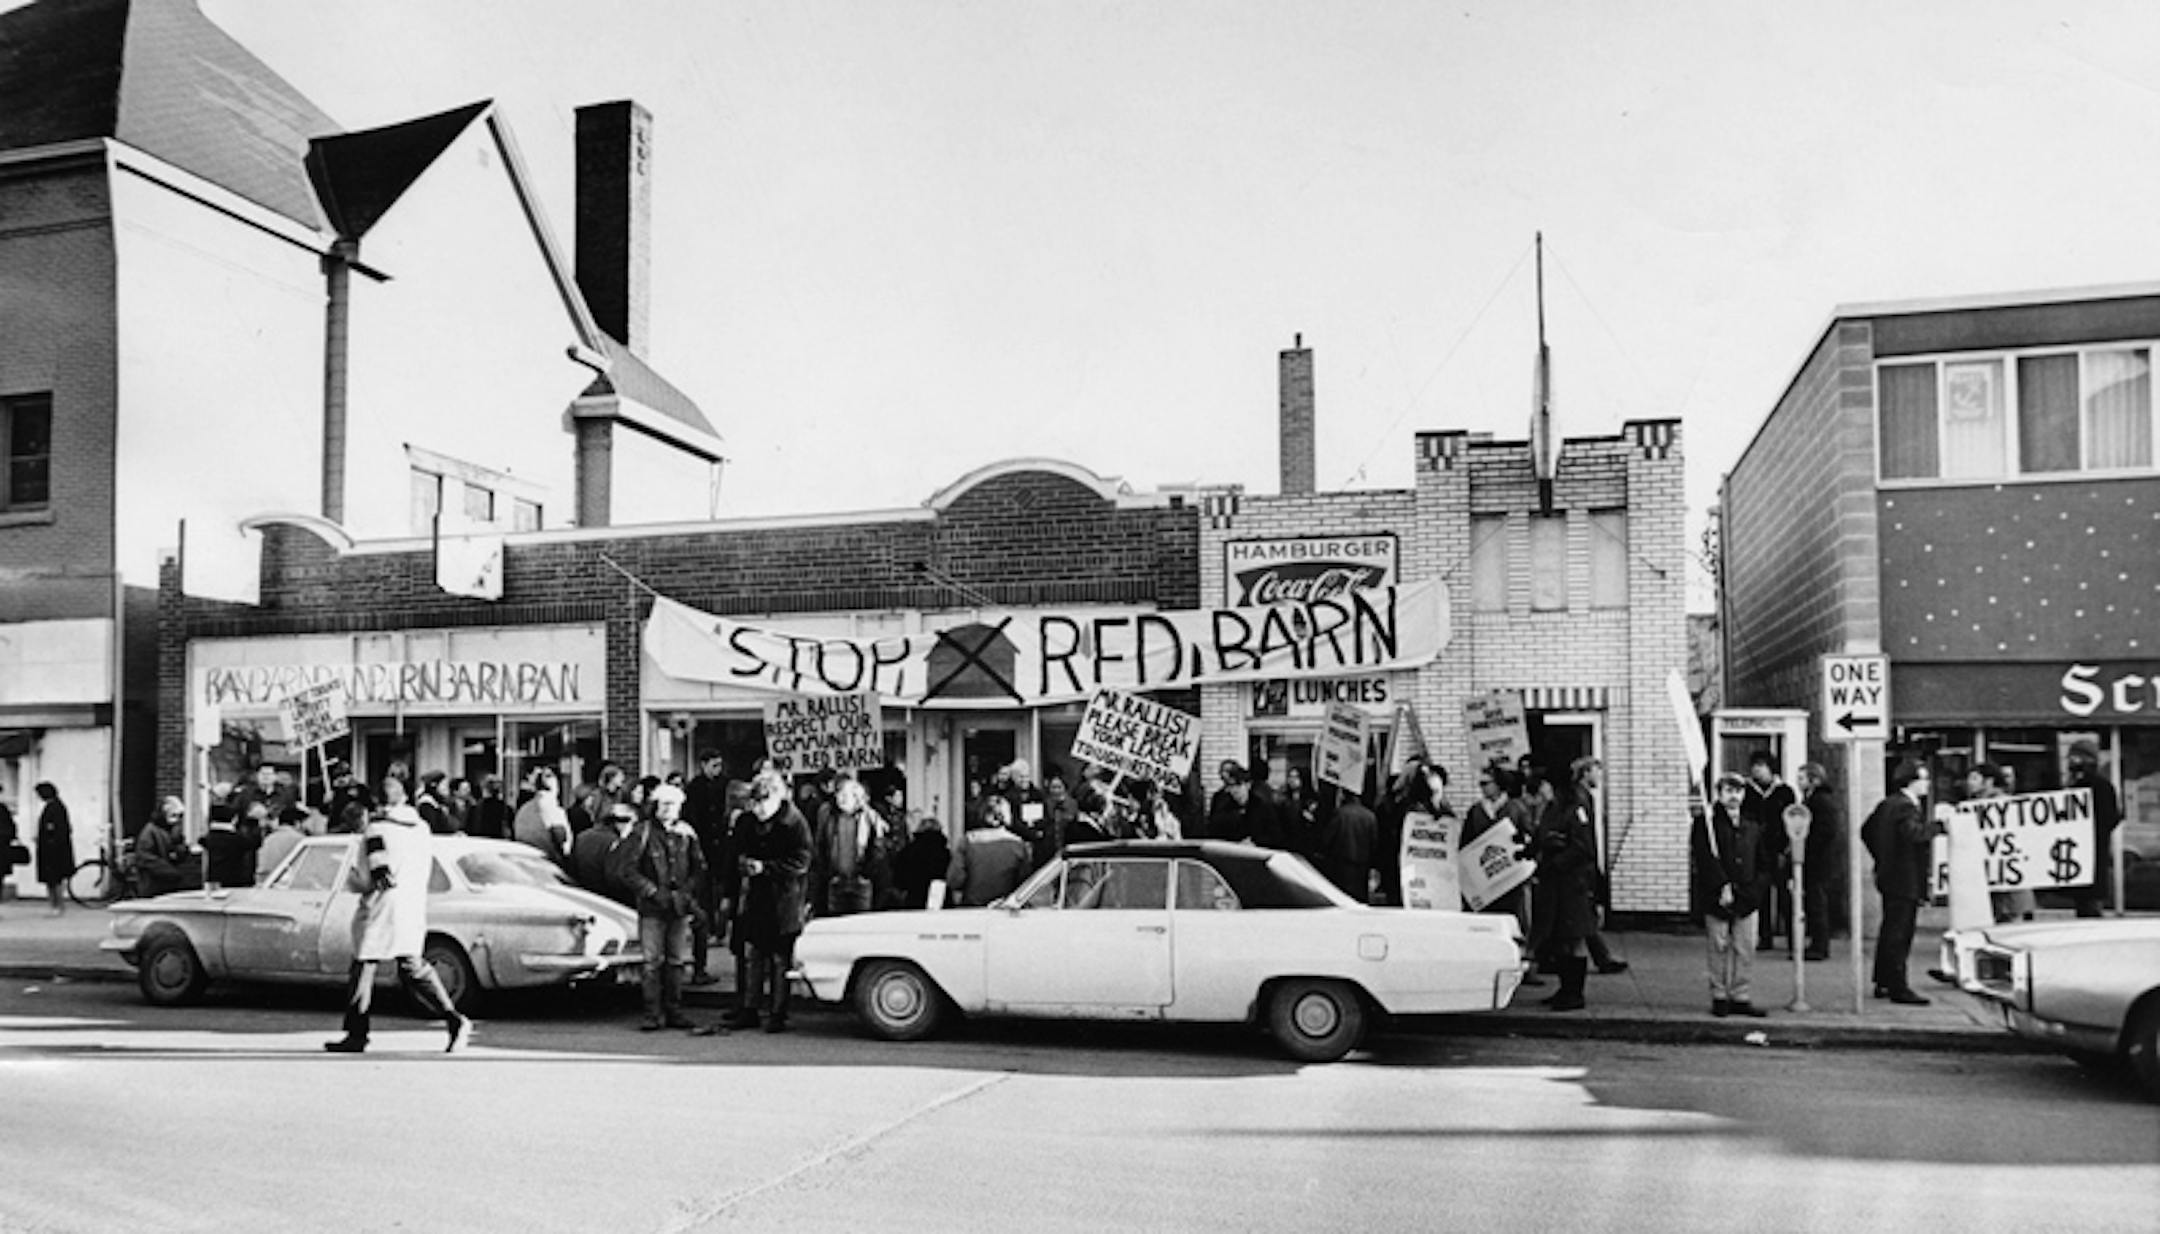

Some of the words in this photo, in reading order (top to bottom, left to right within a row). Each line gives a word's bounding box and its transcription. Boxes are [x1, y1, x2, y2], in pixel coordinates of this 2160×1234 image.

[1233, 540, 1391, 560] HAMBURGER
[729, 626, 911, 697] STOP
[1039, 614, 1183, 696] RED
[1212, 585, 1397, 670] BARN
[1831, 662, 1880, 682] ONE
[1294, 679, 1387, 702] LUNCHES
[1831, 686, 1882, 705] WAY
[765, 717, 827, 737] RESPECT
[839, 713, 872, 731] OUR
[1088, 707, 1141, 736] PLEASE
[1145, 725, 1191, 759] BREAK
[773, 756, 793, 770] NO
[802, 751, 829, 769] RED
[836, 748, 882, 768] BARN
[1130, 741, 1169, 767] LEASE
[2048, 836, 2082, 884] $
